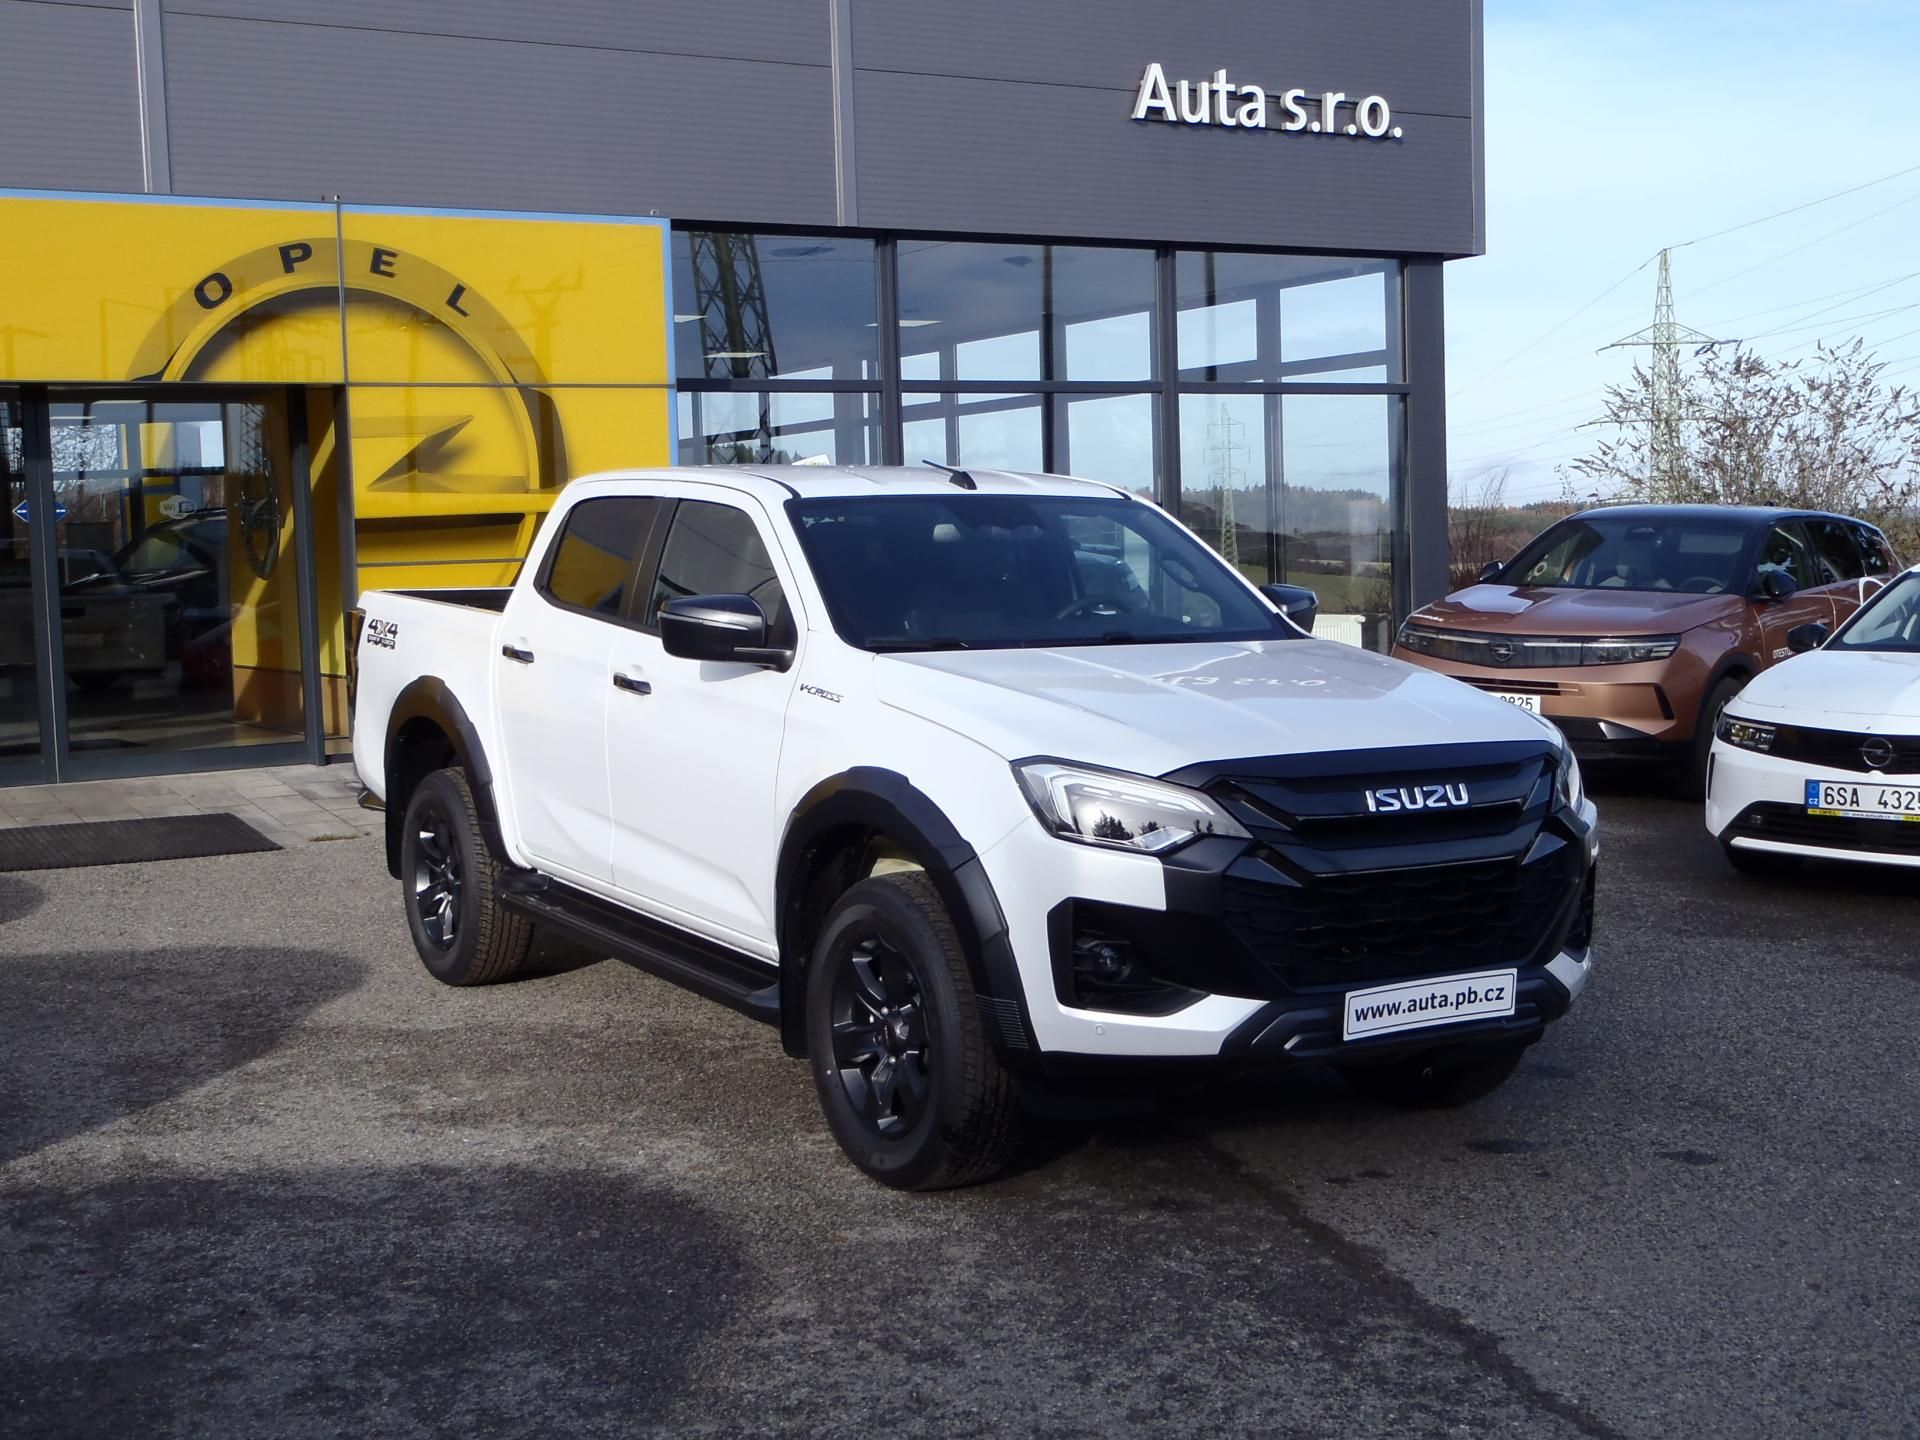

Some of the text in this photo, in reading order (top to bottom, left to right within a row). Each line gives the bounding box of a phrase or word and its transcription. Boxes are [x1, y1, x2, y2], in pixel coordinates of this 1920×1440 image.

[1130, 62, 1403, 139] Auta s.r.o.
[193, 242, 471, 317] OPEL
[1500, 695, 1534, 711] 25
[1365, 783, 1469, 812] ISUZU
[1824, 786, 1920, 811] 6SA 432
[1354, 986, 1505, 1023] www.auta.pb.cz
